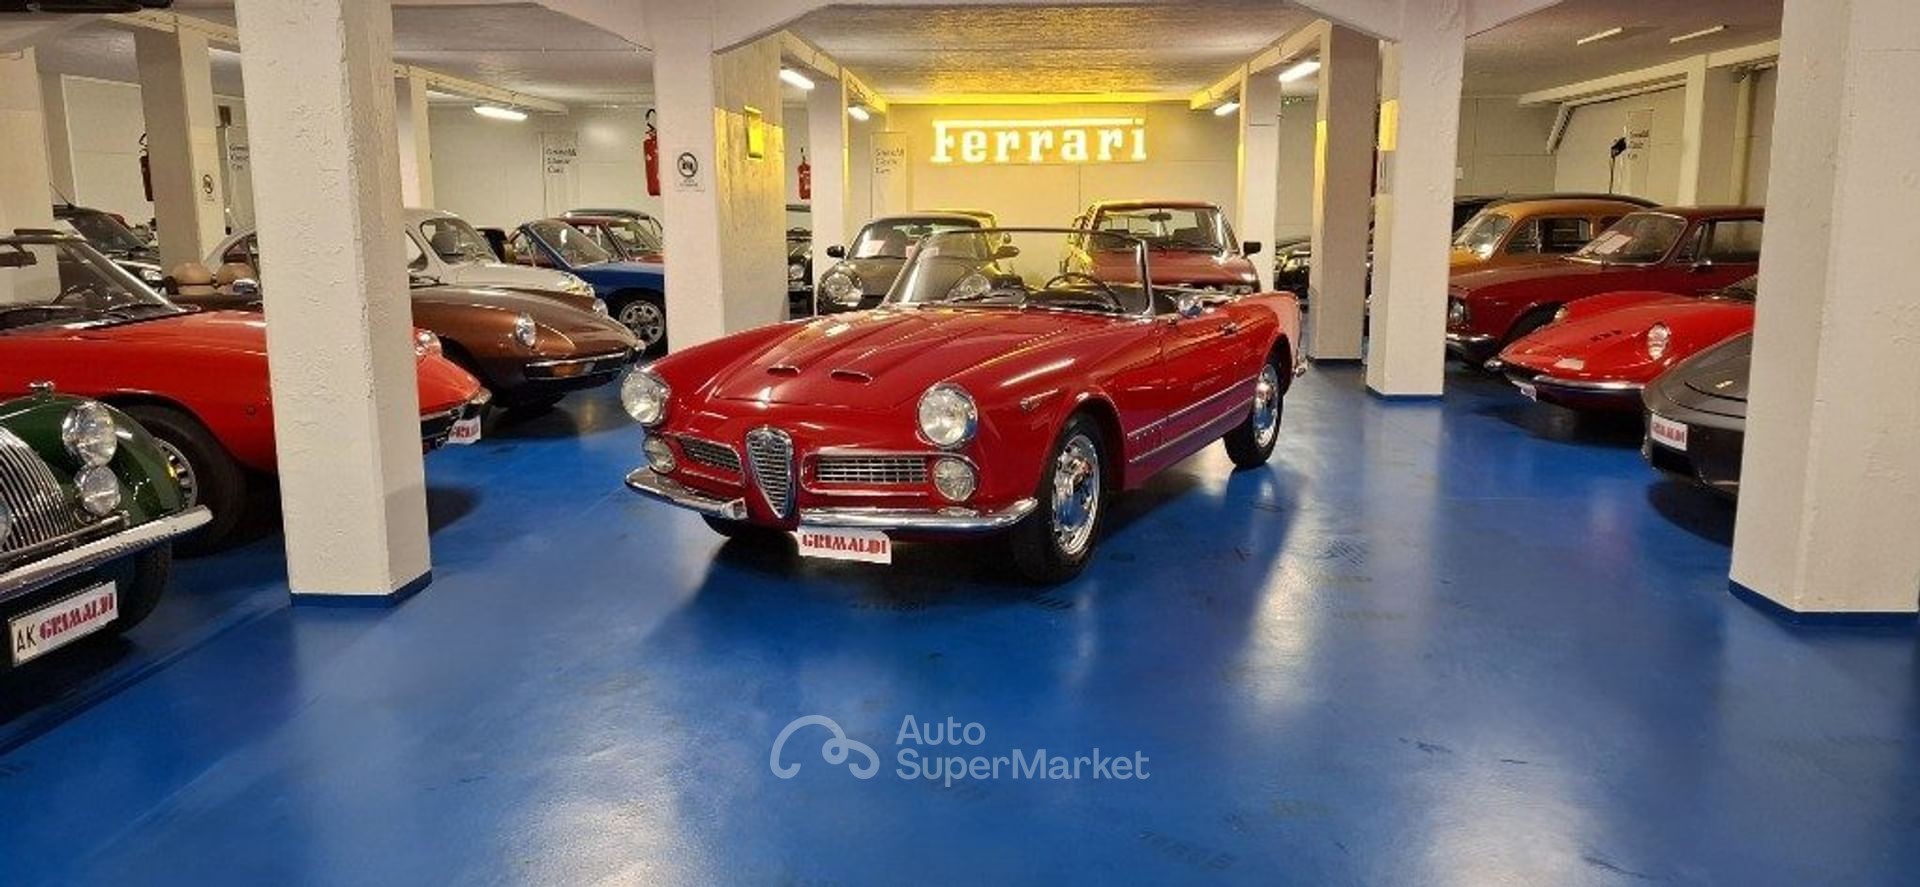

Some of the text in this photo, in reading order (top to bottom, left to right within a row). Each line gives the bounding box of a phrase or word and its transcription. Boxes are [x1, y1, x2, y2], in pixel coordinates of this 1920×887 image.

[930, 118, 1147, 162] Ferrari
[802, 534, 887, 554] GRIMALDI
[17, 592, 114, 653] AK GRIMALDI
